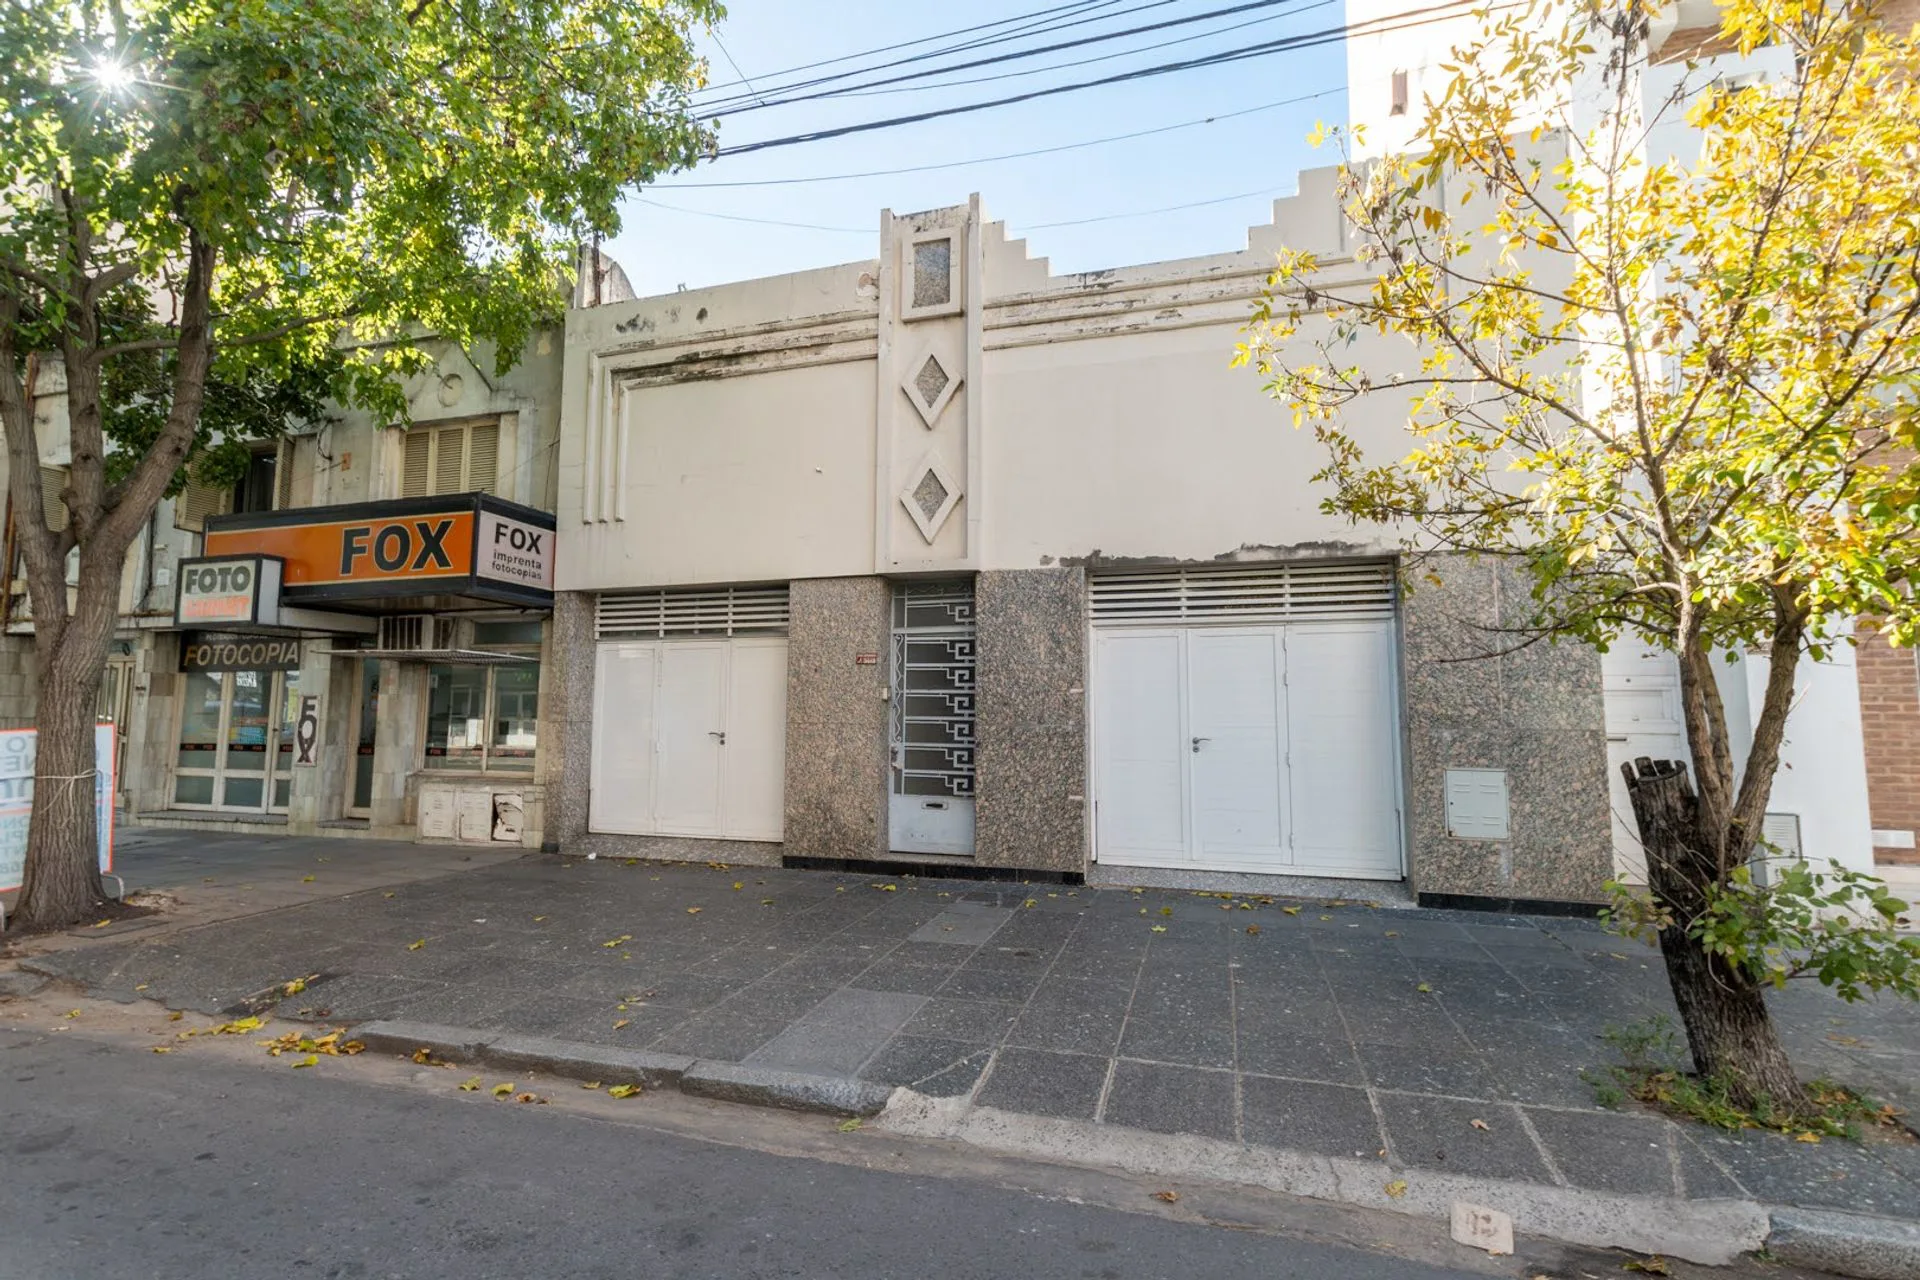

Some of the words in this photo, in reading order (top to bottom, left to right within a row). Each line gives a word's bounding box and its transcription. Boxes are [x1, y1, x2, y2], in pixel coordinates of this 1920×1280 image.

[339, 519, 455, 577] FOX
[494, 522, 542, 555] FOX
[491, 561, 542, 579] fotocopias
[493, 549, 542, 569] imprenta
[185, 565, 251, 594] FOTO
[184, 641, 299, 666] FOTOCOPIA
[297, 695, 318, 764] FOX
